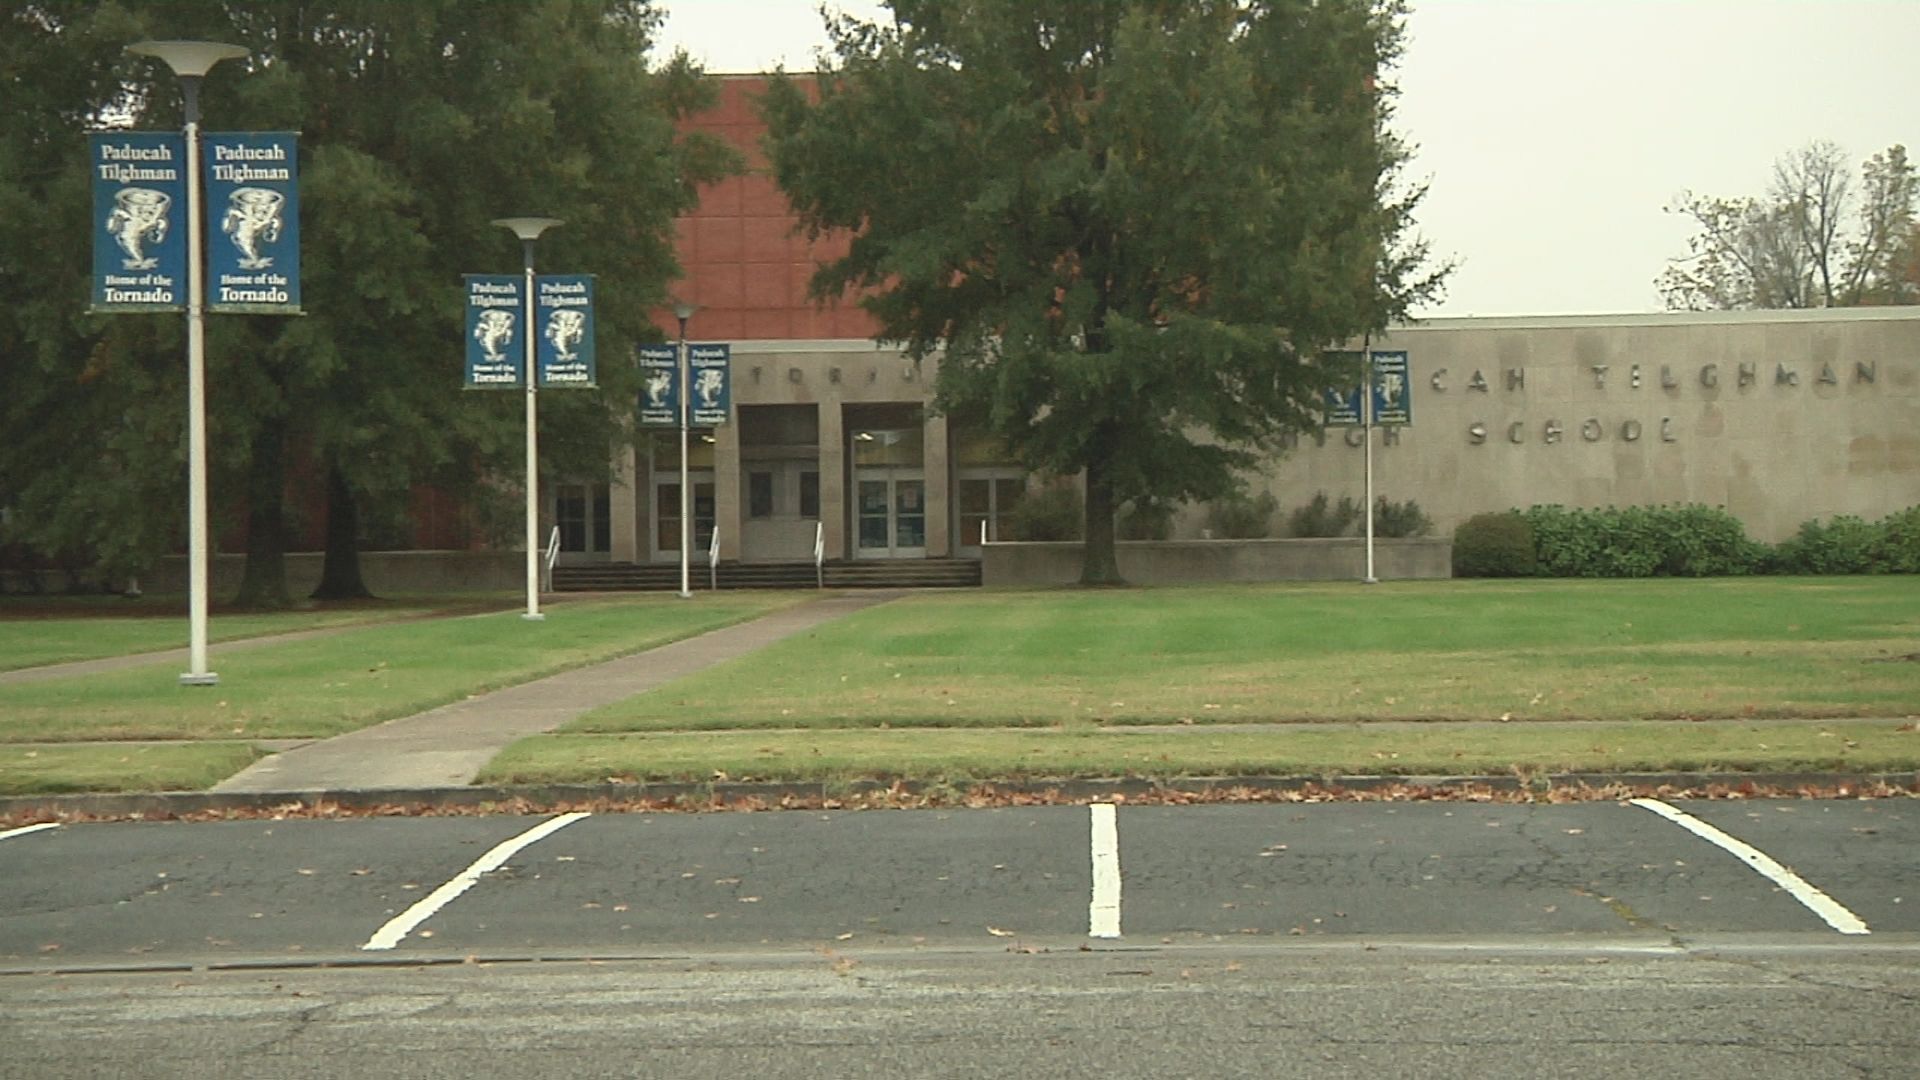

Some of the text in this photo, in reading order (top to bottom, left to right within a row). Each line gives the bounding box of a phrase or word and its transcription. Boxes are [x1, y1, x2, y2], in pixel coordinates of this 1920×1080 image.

[101, 143, 172, 161] Paducah
[214, 143, 286, 161] Paducah
[99, 164, 177, 184] Tilghman
[213, 164, 290, 184] Tilghman
[105, 275, 173, 286] Home of the
[221, 274, 287, 285] Home of the
[104, 287, 173, 303] Tornado
[219, 287, 289, 303] Tornado
[1591, 360, 1876, 390] TILGHMAN
[1469, 417, 1677, 445] SCHOOL
